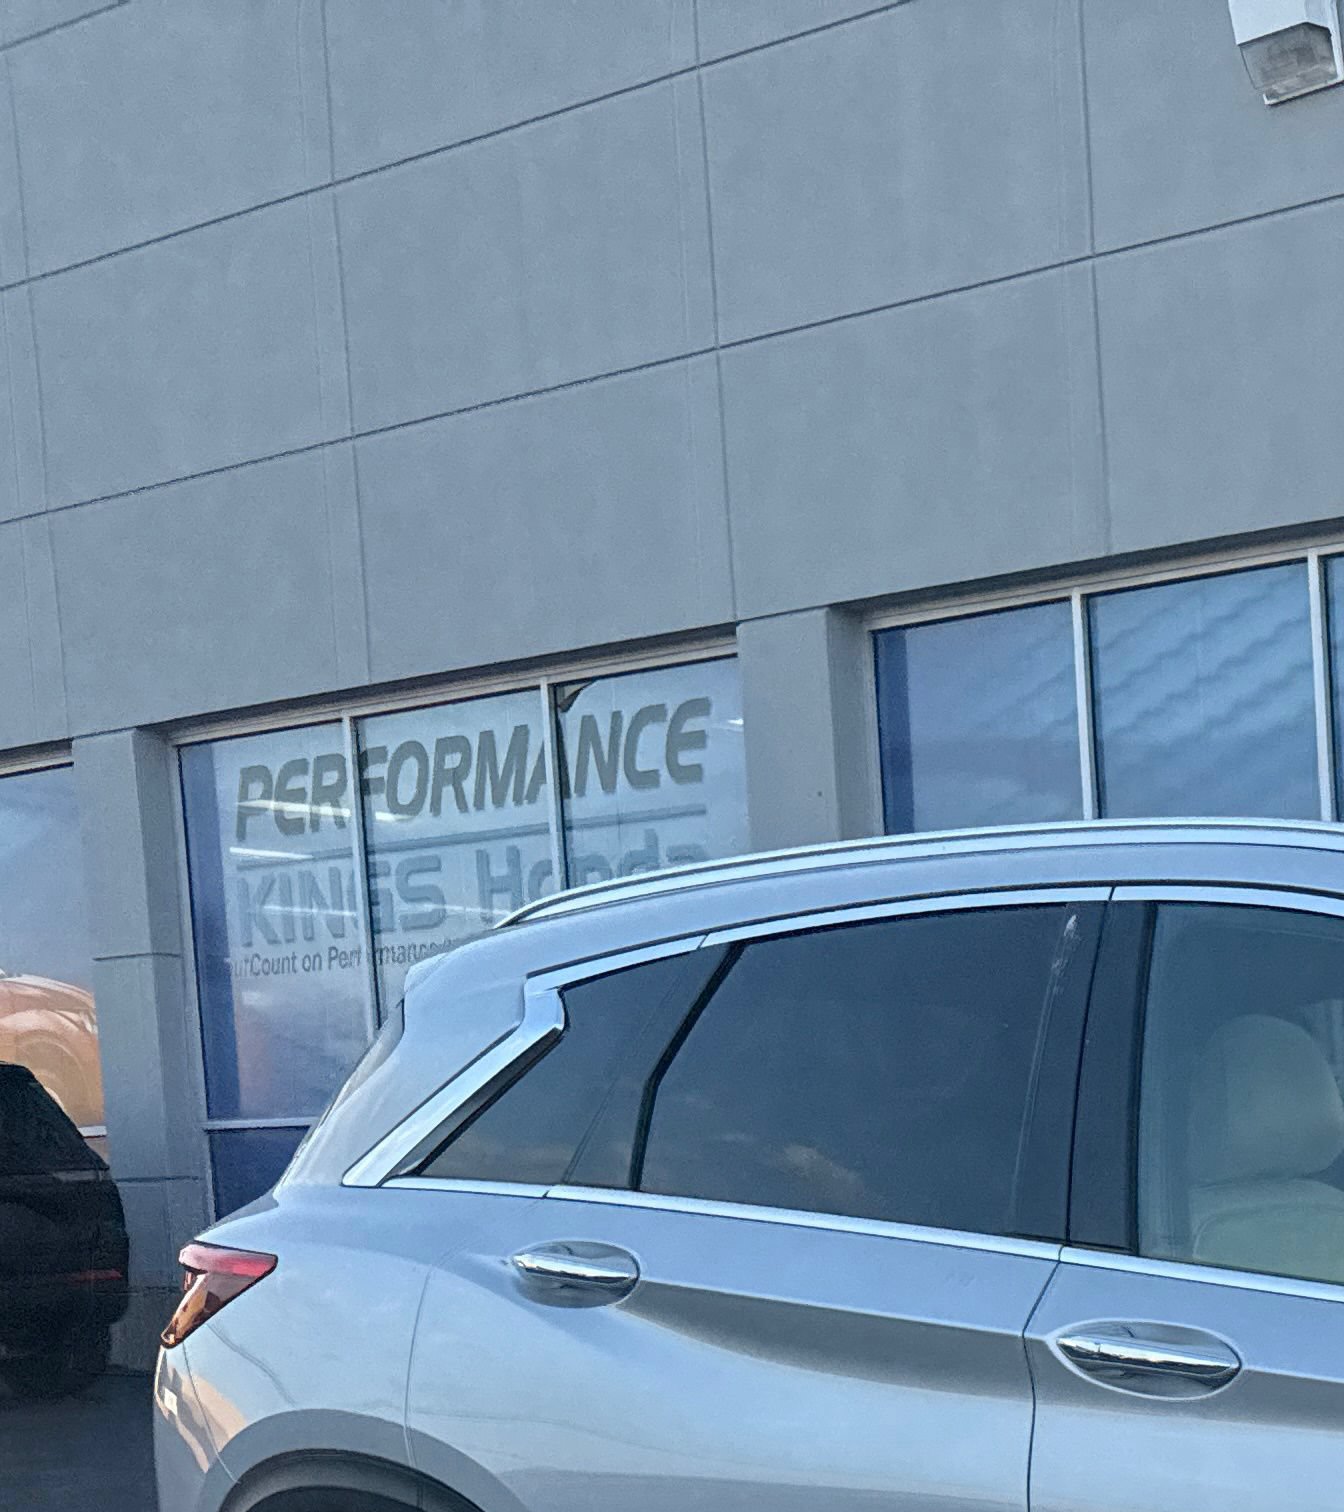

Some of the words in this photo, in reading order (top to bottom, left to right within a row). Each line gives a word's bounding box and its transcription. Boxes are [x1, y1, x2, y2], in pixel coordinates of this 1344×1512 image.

[235, 697, 712, 842] PERFORMANCE
[235, 854, 447, 947] KINGS
[301, 952, 323, 974] on
